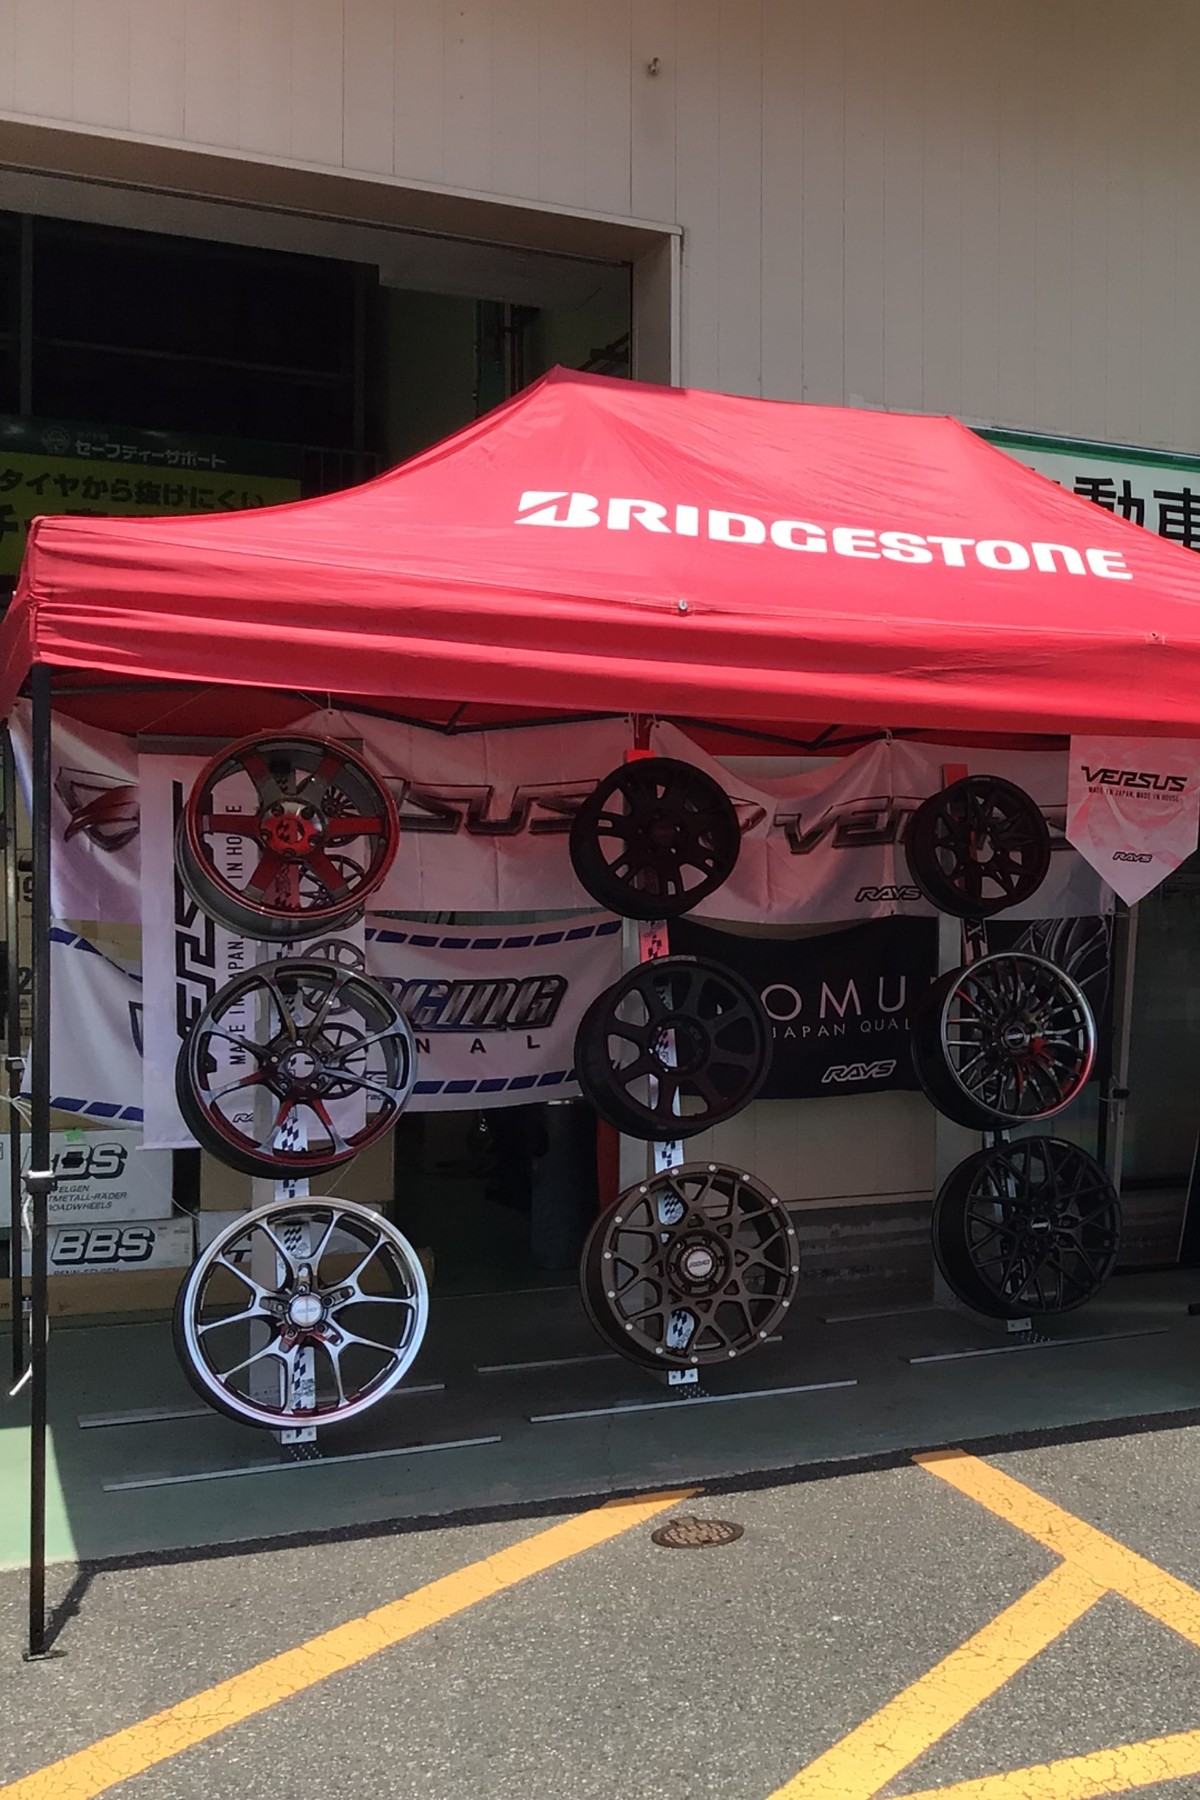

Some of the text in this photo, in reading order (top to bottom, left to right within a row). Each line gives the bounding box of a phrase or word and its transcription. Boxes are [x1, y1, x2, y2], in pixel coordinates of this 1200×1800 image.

[75, 441, 226, 468] セーフティーサポート
[513, 490, 1134, 581] BRIDGESTONE
[1081, 766, 1187, 792] VERSUS
[1112, 851, 1153, 863] RAYS
[855, 886, 923, 902] RAYS
[820, 1058, 898, 1083] RAYS
[51, 1227, 156, 1266] BBS
